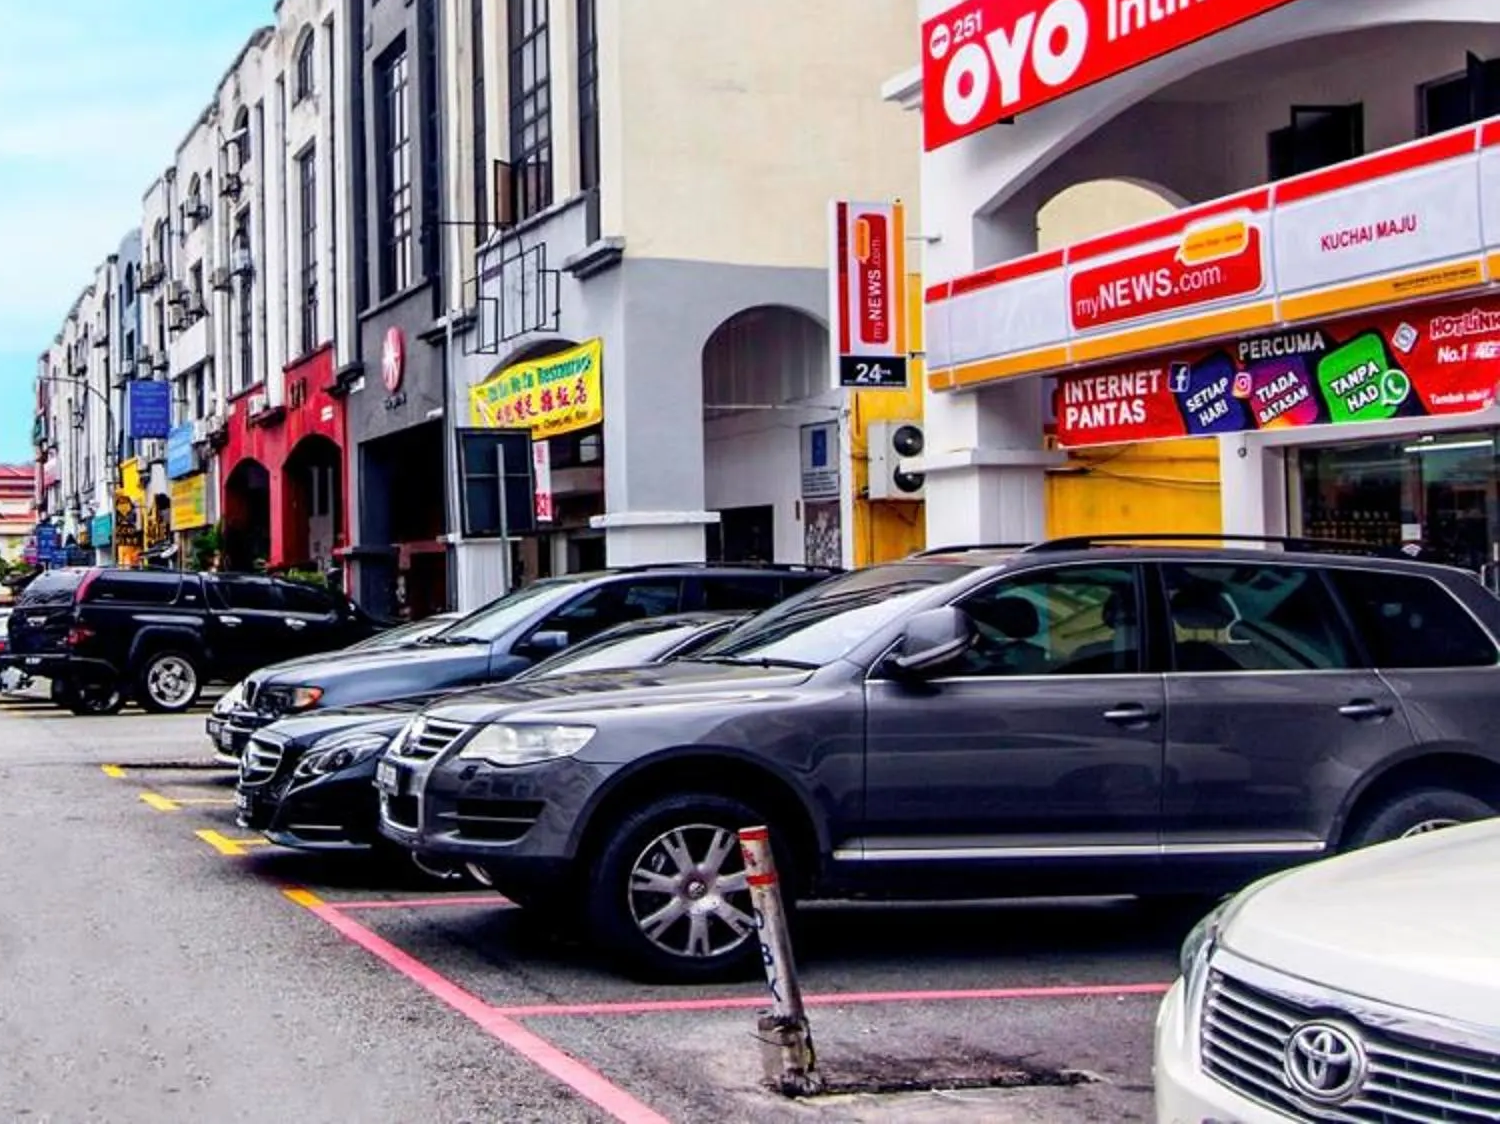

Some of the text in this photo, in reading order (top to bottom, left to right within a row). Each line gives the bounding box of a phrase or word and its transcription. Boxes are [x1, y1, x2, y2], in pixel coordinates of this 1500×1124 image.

[951, 8, 983, 44] 251
[1320, 213, 1417, 252] KUCHAI MAJU
[1075, 264, 1222, 319] myNEWS.com
[1238, 330, 1326, 361] PERCUMA
[855, 362, 883, 384] 24
[1064, 368, 1162, 405] INTERNET
[1255, 370, 1299, 403] TIADA
[1330, 360, 1380, 395] TANPA
[1185, 376, 1229, 413] SETIAP
[1258, 384, 1310, 423] BATASAN
[1346, 384, 1380, 413] HAD
[1065, 400, 1146, 431] PANTAS
[1198, 399, 1230, 427] HARI
